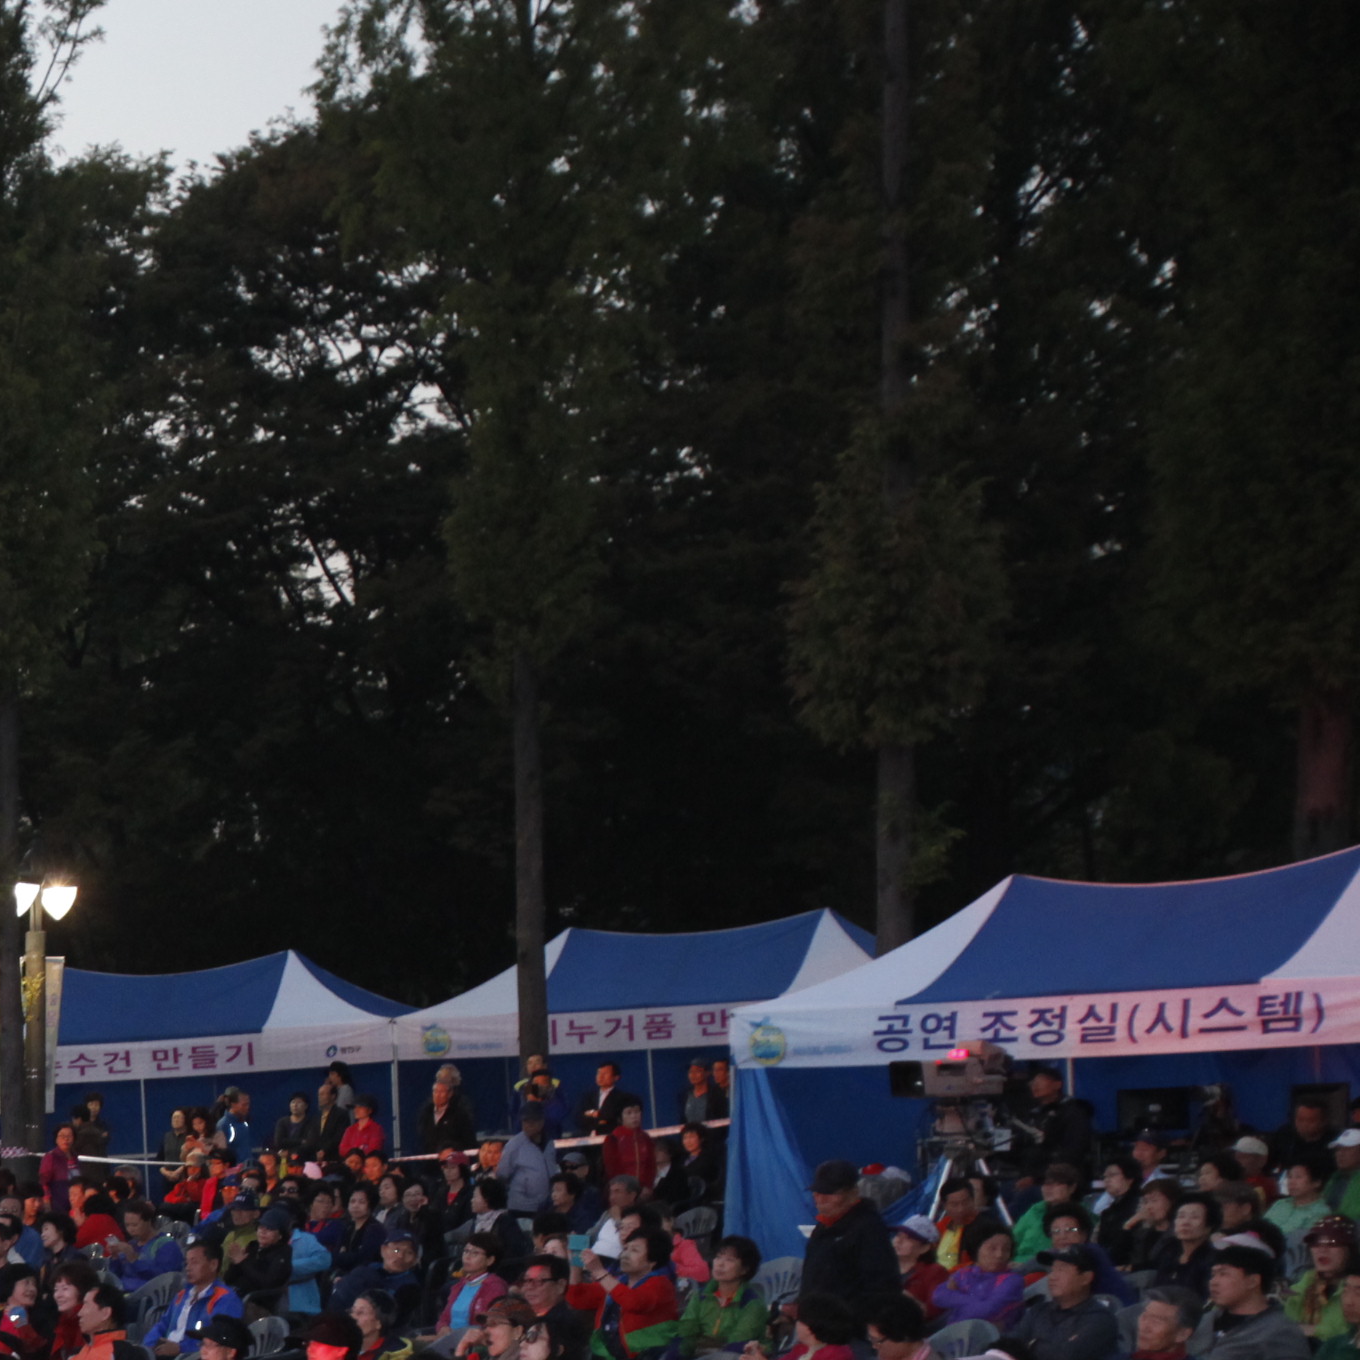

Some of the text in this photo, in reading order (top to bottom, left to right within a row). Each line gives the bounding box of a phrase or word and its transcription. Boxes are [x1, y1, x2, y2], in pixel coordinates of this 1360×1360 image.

[873, 991, 1324, 1052] 공연 조정실(시스템)
[151, 1042, 255, 1071] 만들기
